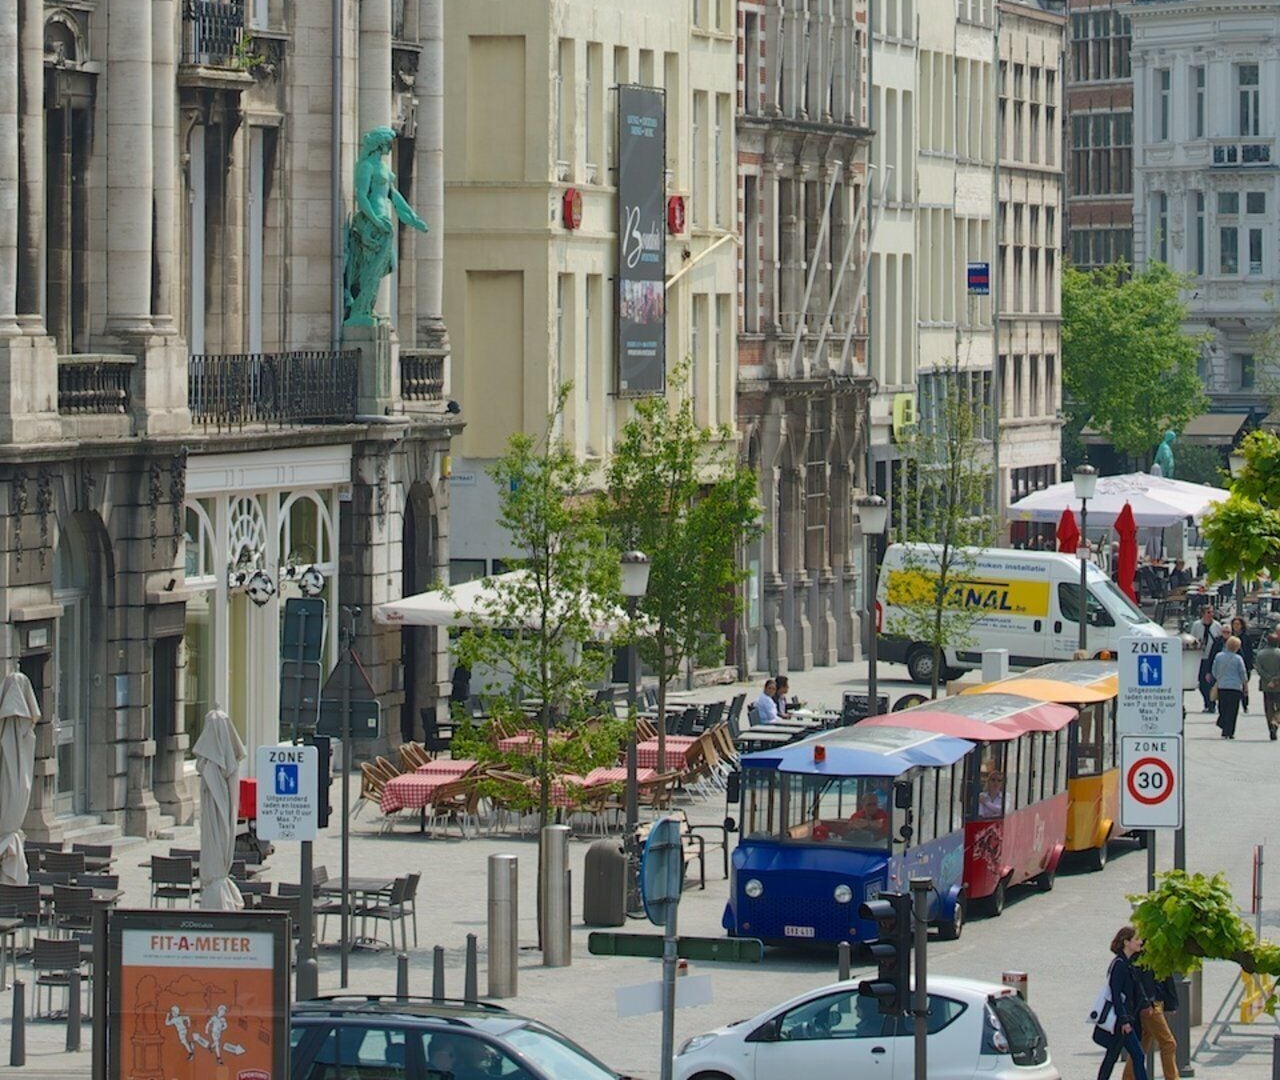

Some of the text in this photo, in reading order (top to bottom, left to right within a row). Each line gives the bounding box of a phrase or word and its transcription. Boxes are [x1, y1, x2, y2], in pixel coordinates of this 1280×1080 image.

[1131, 642, 1169, 654] ZONE
[1127, 686, 1172, 695] Uitgezonderd
[1124, 693, 1143, 701] laden
[1134, 742, 1168, 752] ZONE
[269, 751, 305, 763] ZONE
[1138, 772, 1164, 789] 30
[266, 794, 308, 802] Uitgezonderd
[150, 935, 251, 952] FIT-A-METER
